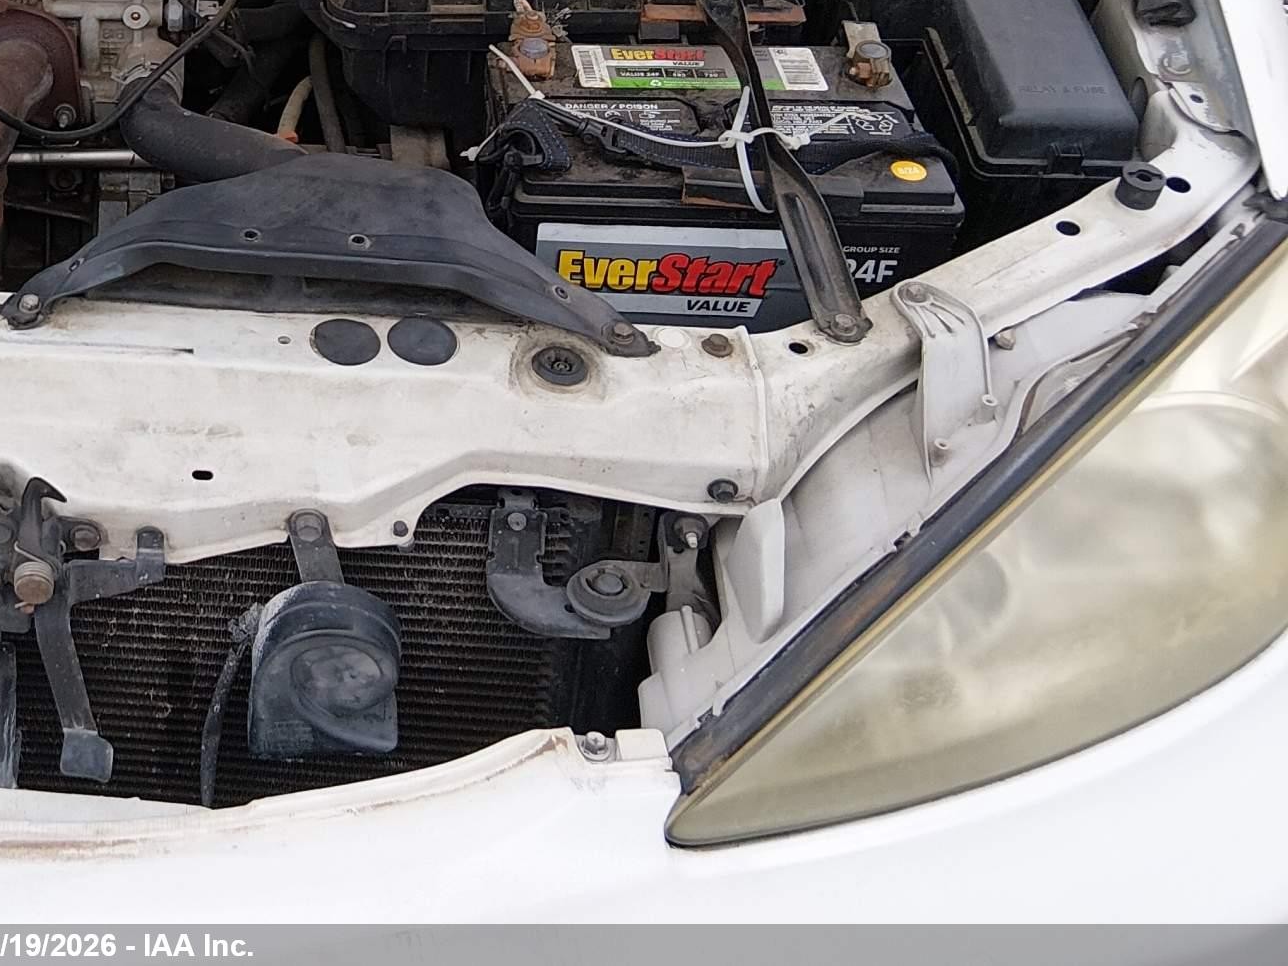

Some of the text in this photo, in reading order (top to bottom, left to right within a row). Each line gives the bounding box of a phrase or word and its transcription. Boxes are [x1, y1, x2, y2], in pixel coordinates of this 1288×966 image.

[611, 47, 705, 60] EverStart
[842, 245, 901, 254] GROUP SIZE
[556, 249, 778, 298] EverStart
[686, 300, 751, 313] VALUE
